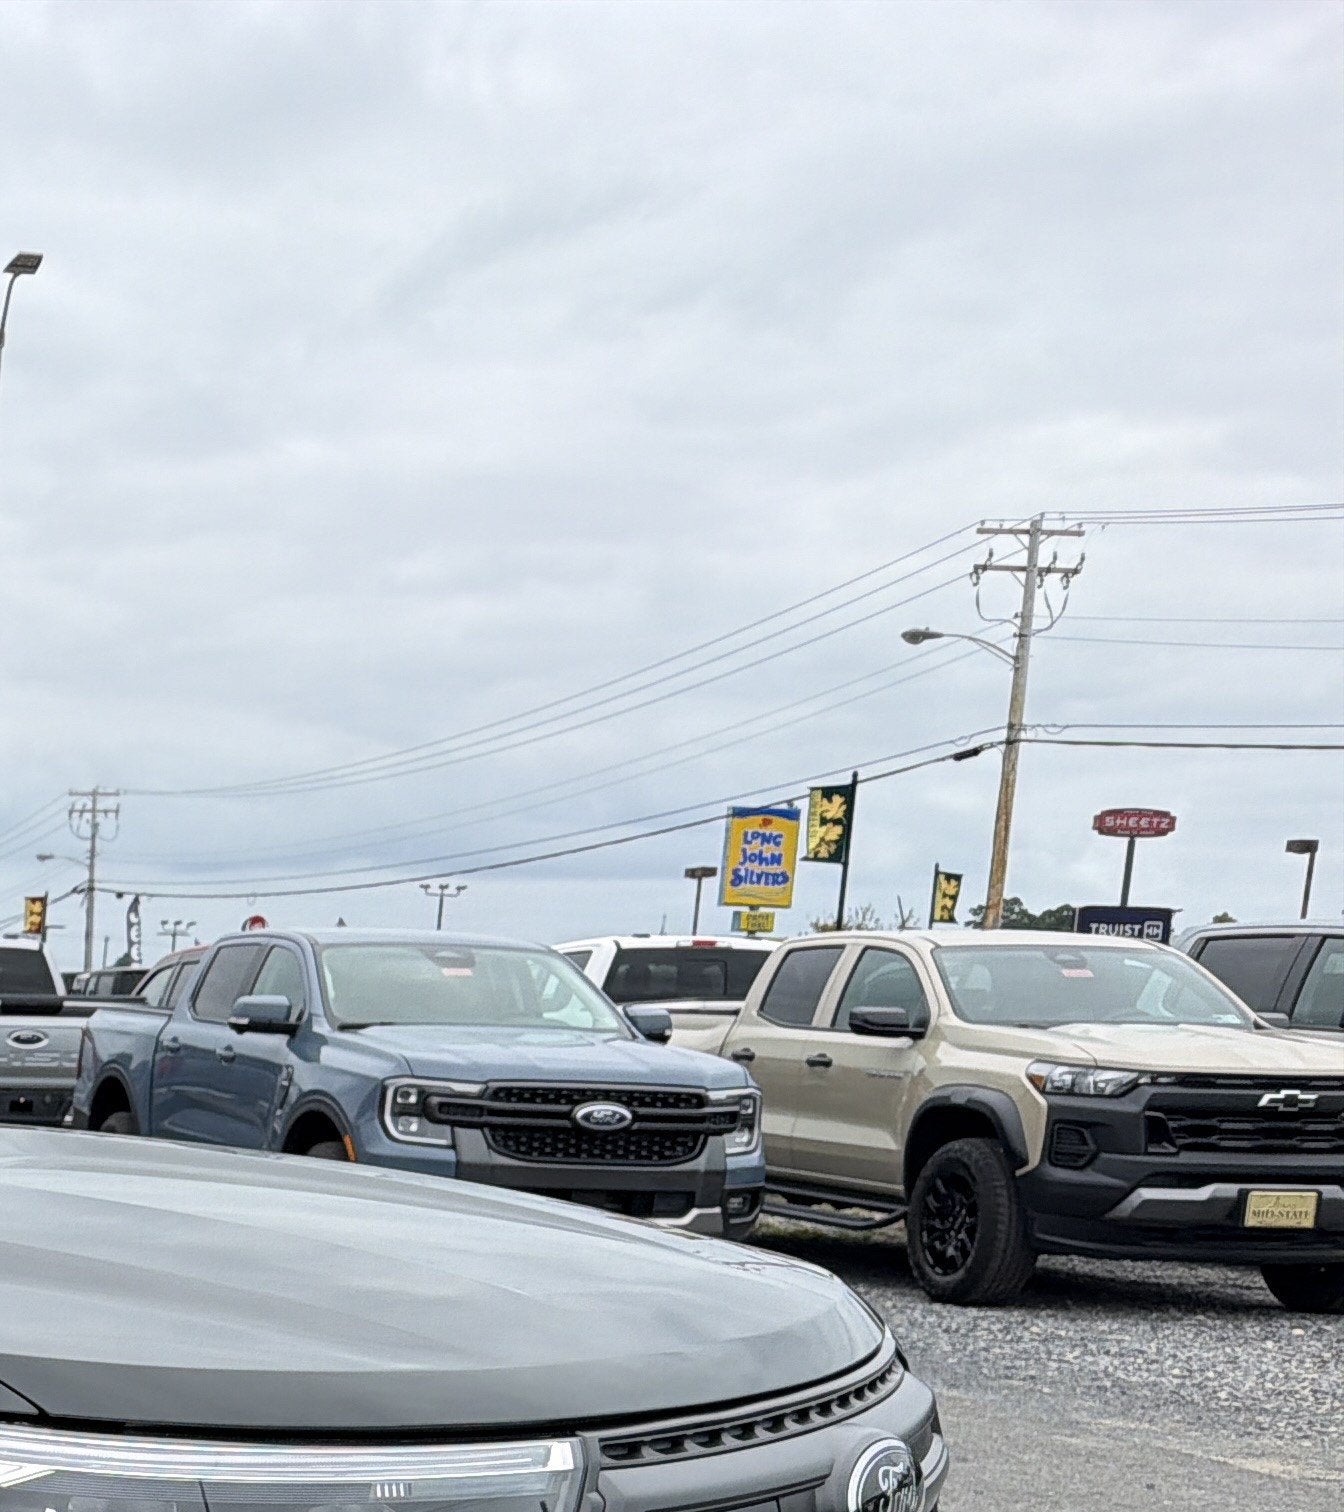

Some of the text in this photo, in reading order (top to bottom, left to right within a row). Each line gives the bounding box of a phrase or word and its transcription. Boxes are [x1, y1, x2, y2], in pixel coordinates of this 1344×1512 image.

[1105, 816, 1170, 828] SHEETZ
[743, 830, 784, 847] LONG
[1089, 922, 1142, 937] TRUIST
